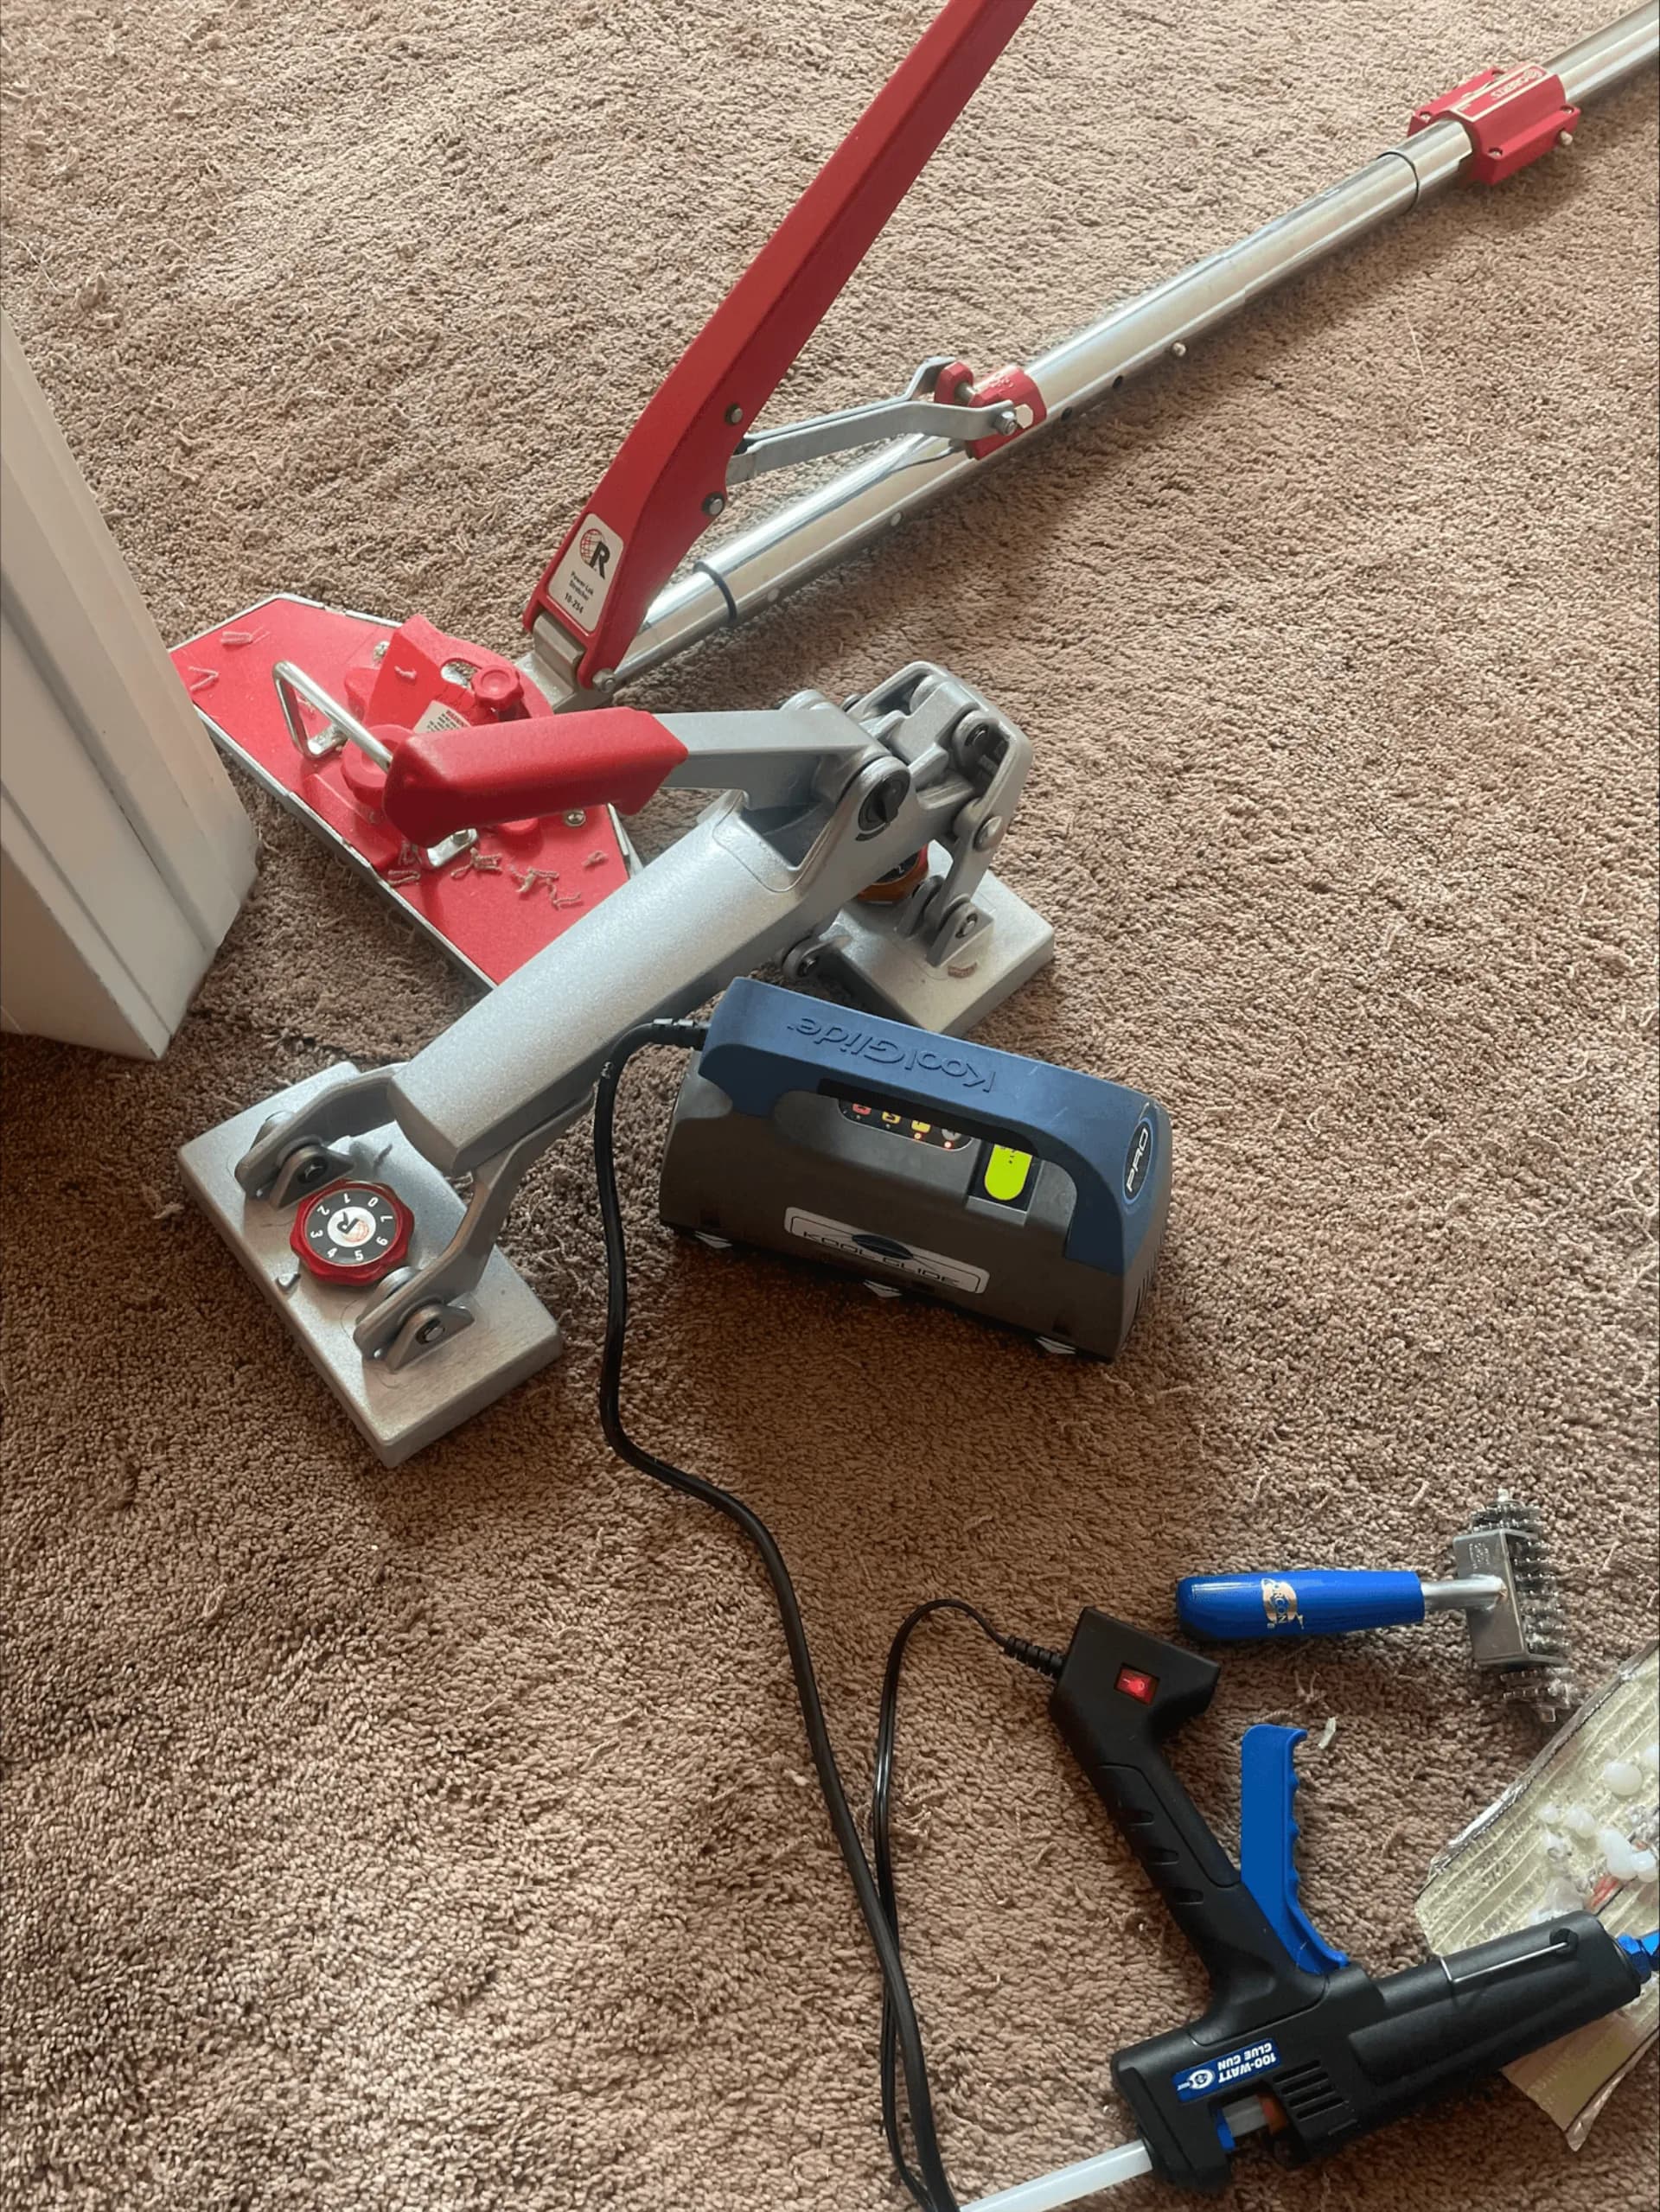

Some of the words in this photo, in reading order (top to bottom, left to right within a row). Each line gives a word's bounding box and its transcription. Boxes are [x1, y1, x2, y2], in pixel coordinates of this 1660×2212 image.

[589, 541, 610, 579] R
[796, 1017, 997, 1093] KoolGlide
[1127, 1128, 1149, 1192] PRO
[1270, 1582, 1287, 1623] ORCON
[1217, 2054, 1242, 2071] GUN
[1218, 2052, 1277, 2083] 100-WATT
[1244, 2043, 1273, 2061] GLUE
